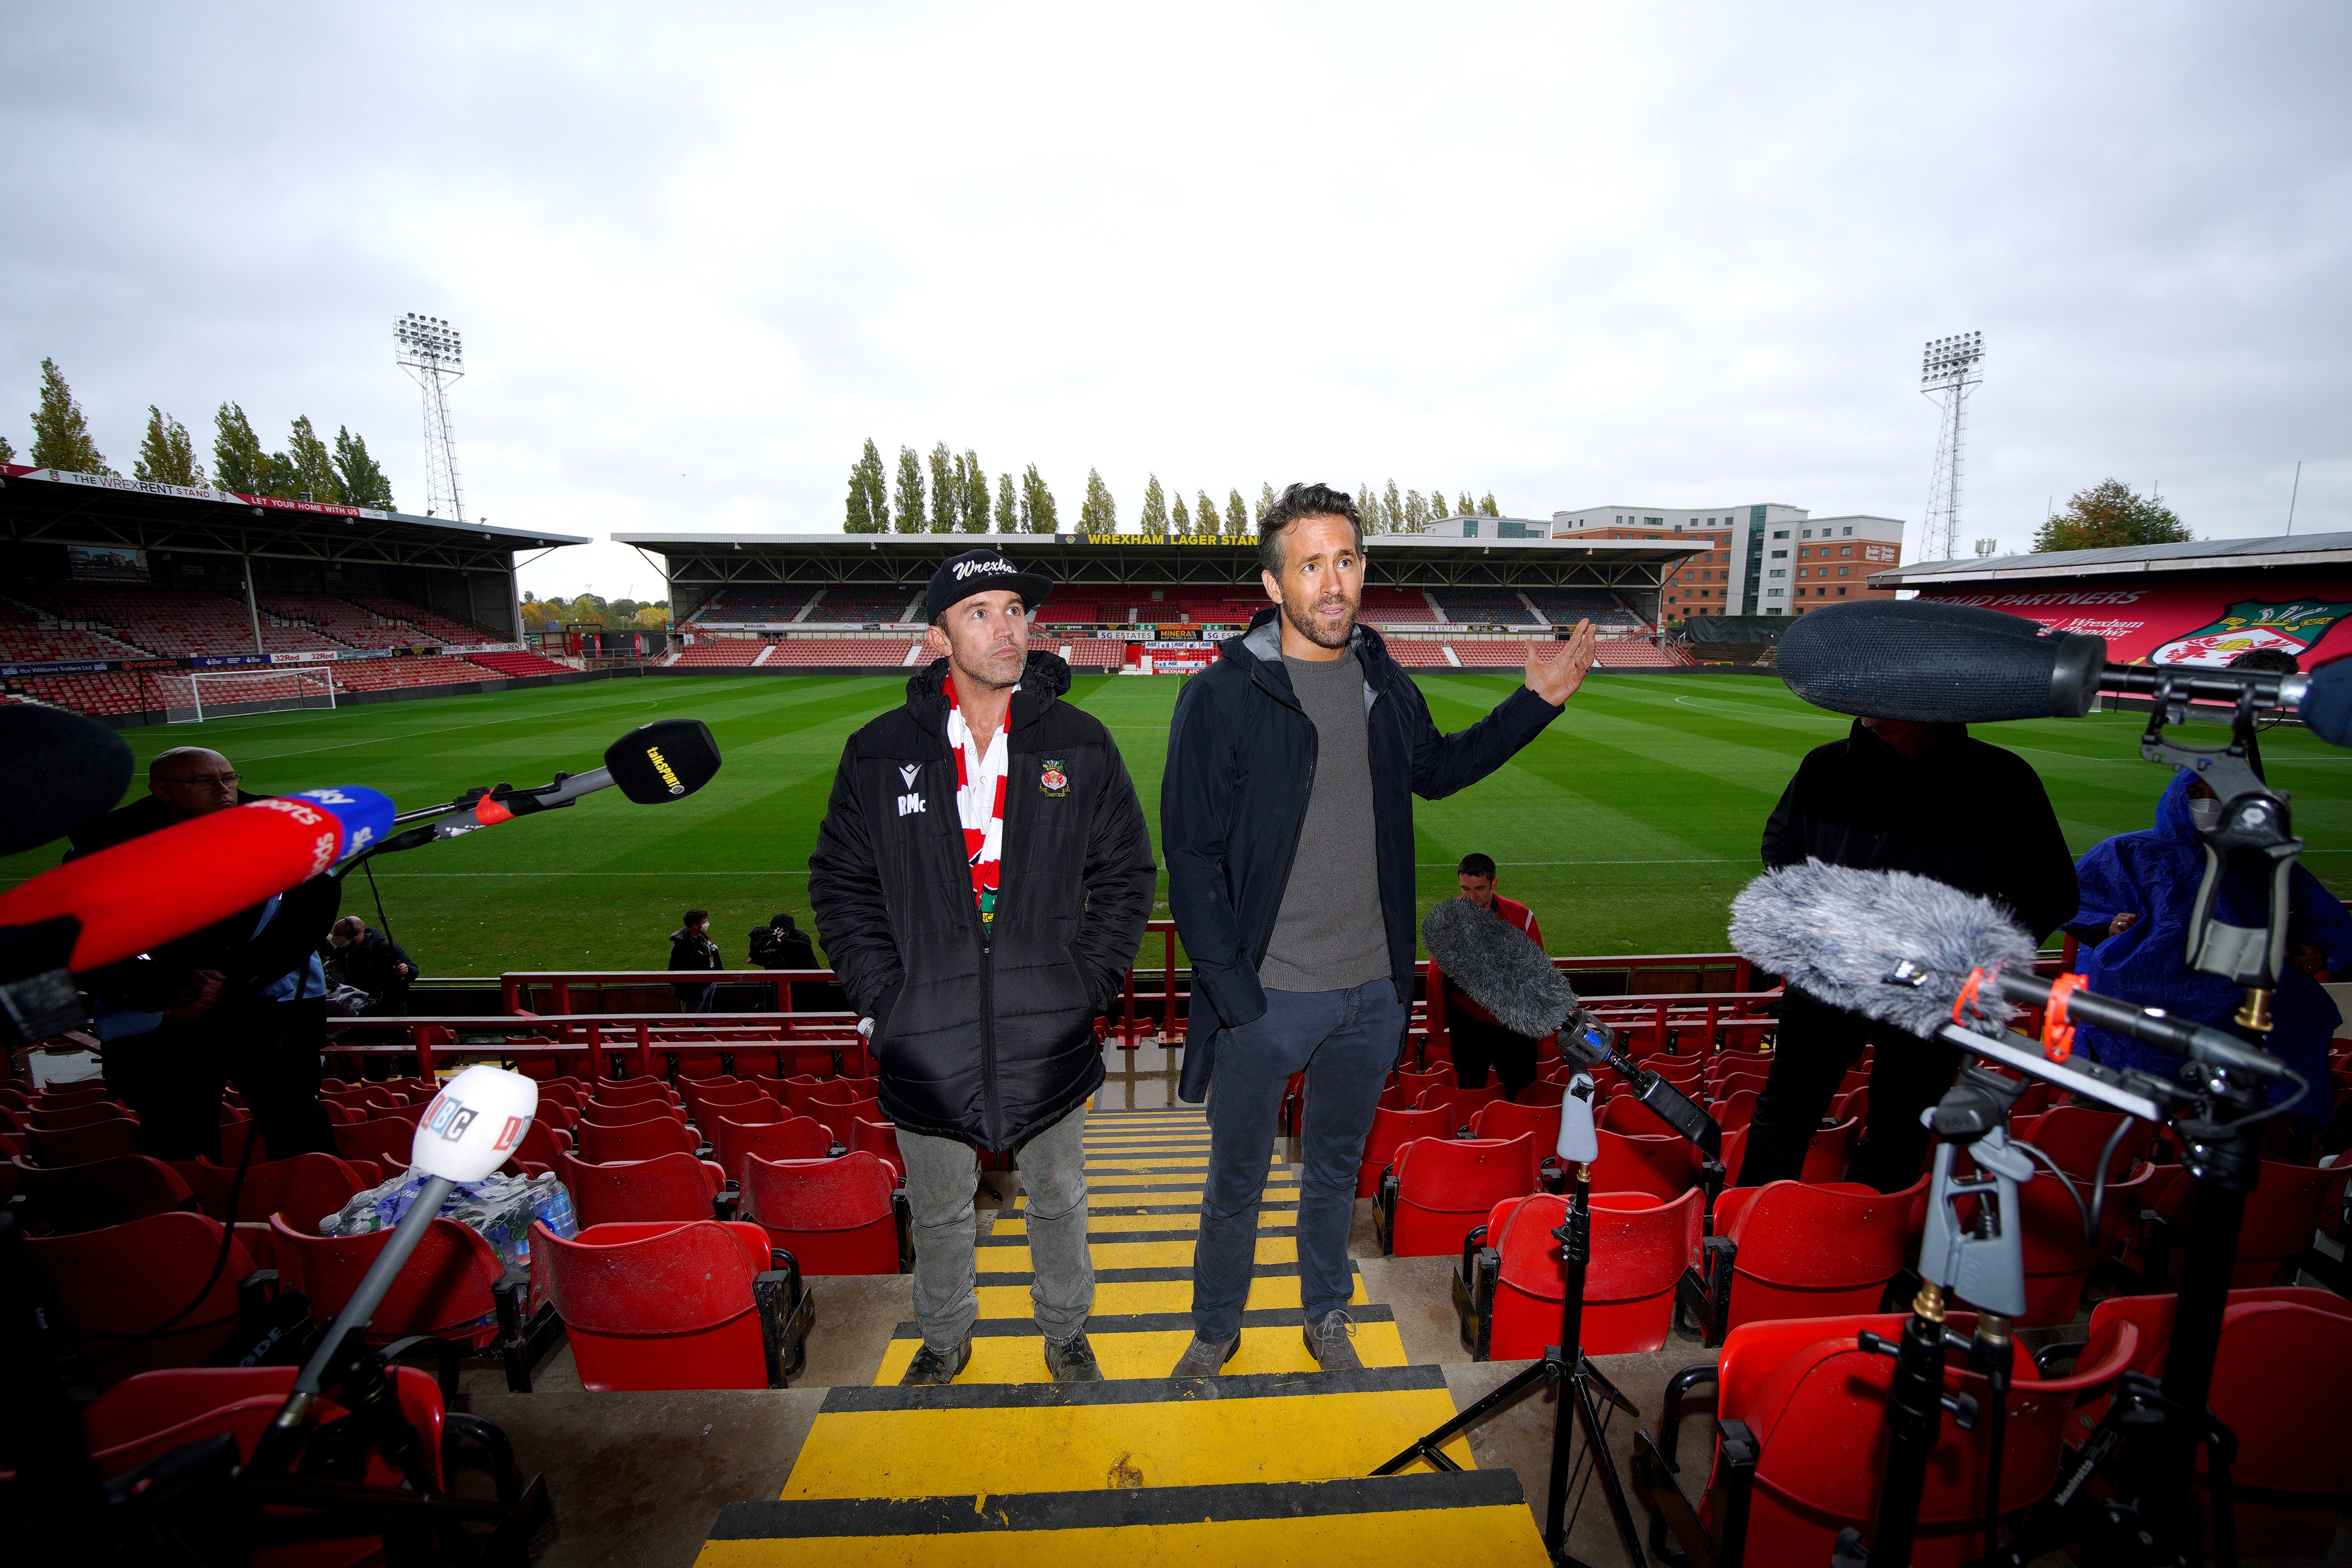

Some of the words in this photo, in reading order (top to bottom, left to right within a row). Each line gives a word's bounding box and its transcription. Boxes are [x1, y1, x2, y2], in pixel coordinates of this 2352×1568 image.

[72, 474, 97, 484] THE
[99, 476, 173, 494] WREXRENT
[176, 488, 210, 498] STAND
[252, 497, 267, 505] LET
[271, 499, 295, 508] YOUR
[298, 503, 322, 512] HOME
[325, 506, 346, 515] WITH
[1088, 534, 1164, 544] WREXHAM
[1170, 534, 1217, 545] LAGER
[1221, 535, 1258, 545] STAN
[1917, 595, 1995, 606] PROUD
[1990, 590, 2148, 606] PARTNERS
[2069, 619, 2145, 628] Wrexham
[2301, 617, 2332, 626] DIEN
[133, 660, 177, 668] vanarama
[646, 746, 681, 788] talkSPORT
[305, 832, 334, 881] spo
[496, 1116, 532, 1149] LB
